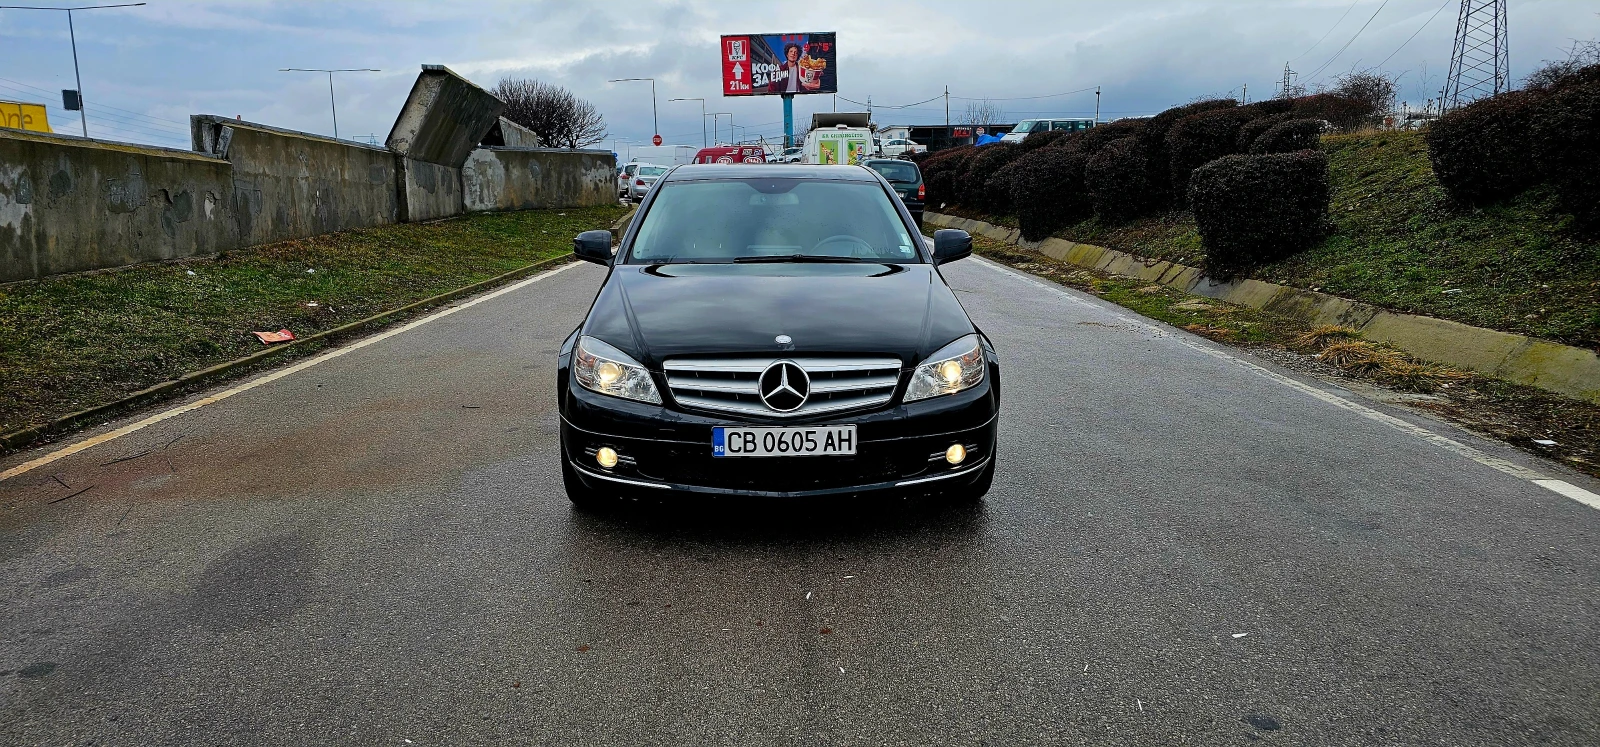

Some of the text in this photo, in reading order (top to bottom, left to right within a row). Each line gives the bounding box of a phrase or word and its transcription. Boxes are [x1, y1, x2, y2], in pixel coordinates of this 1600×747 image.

[752, 63, 780, 74] КОФА
[730, 80, 740, 90] 21
[753, 70, 789, 87] ЗА ЕДИН
[727, 429, 852, 453] CB 0605 AH
